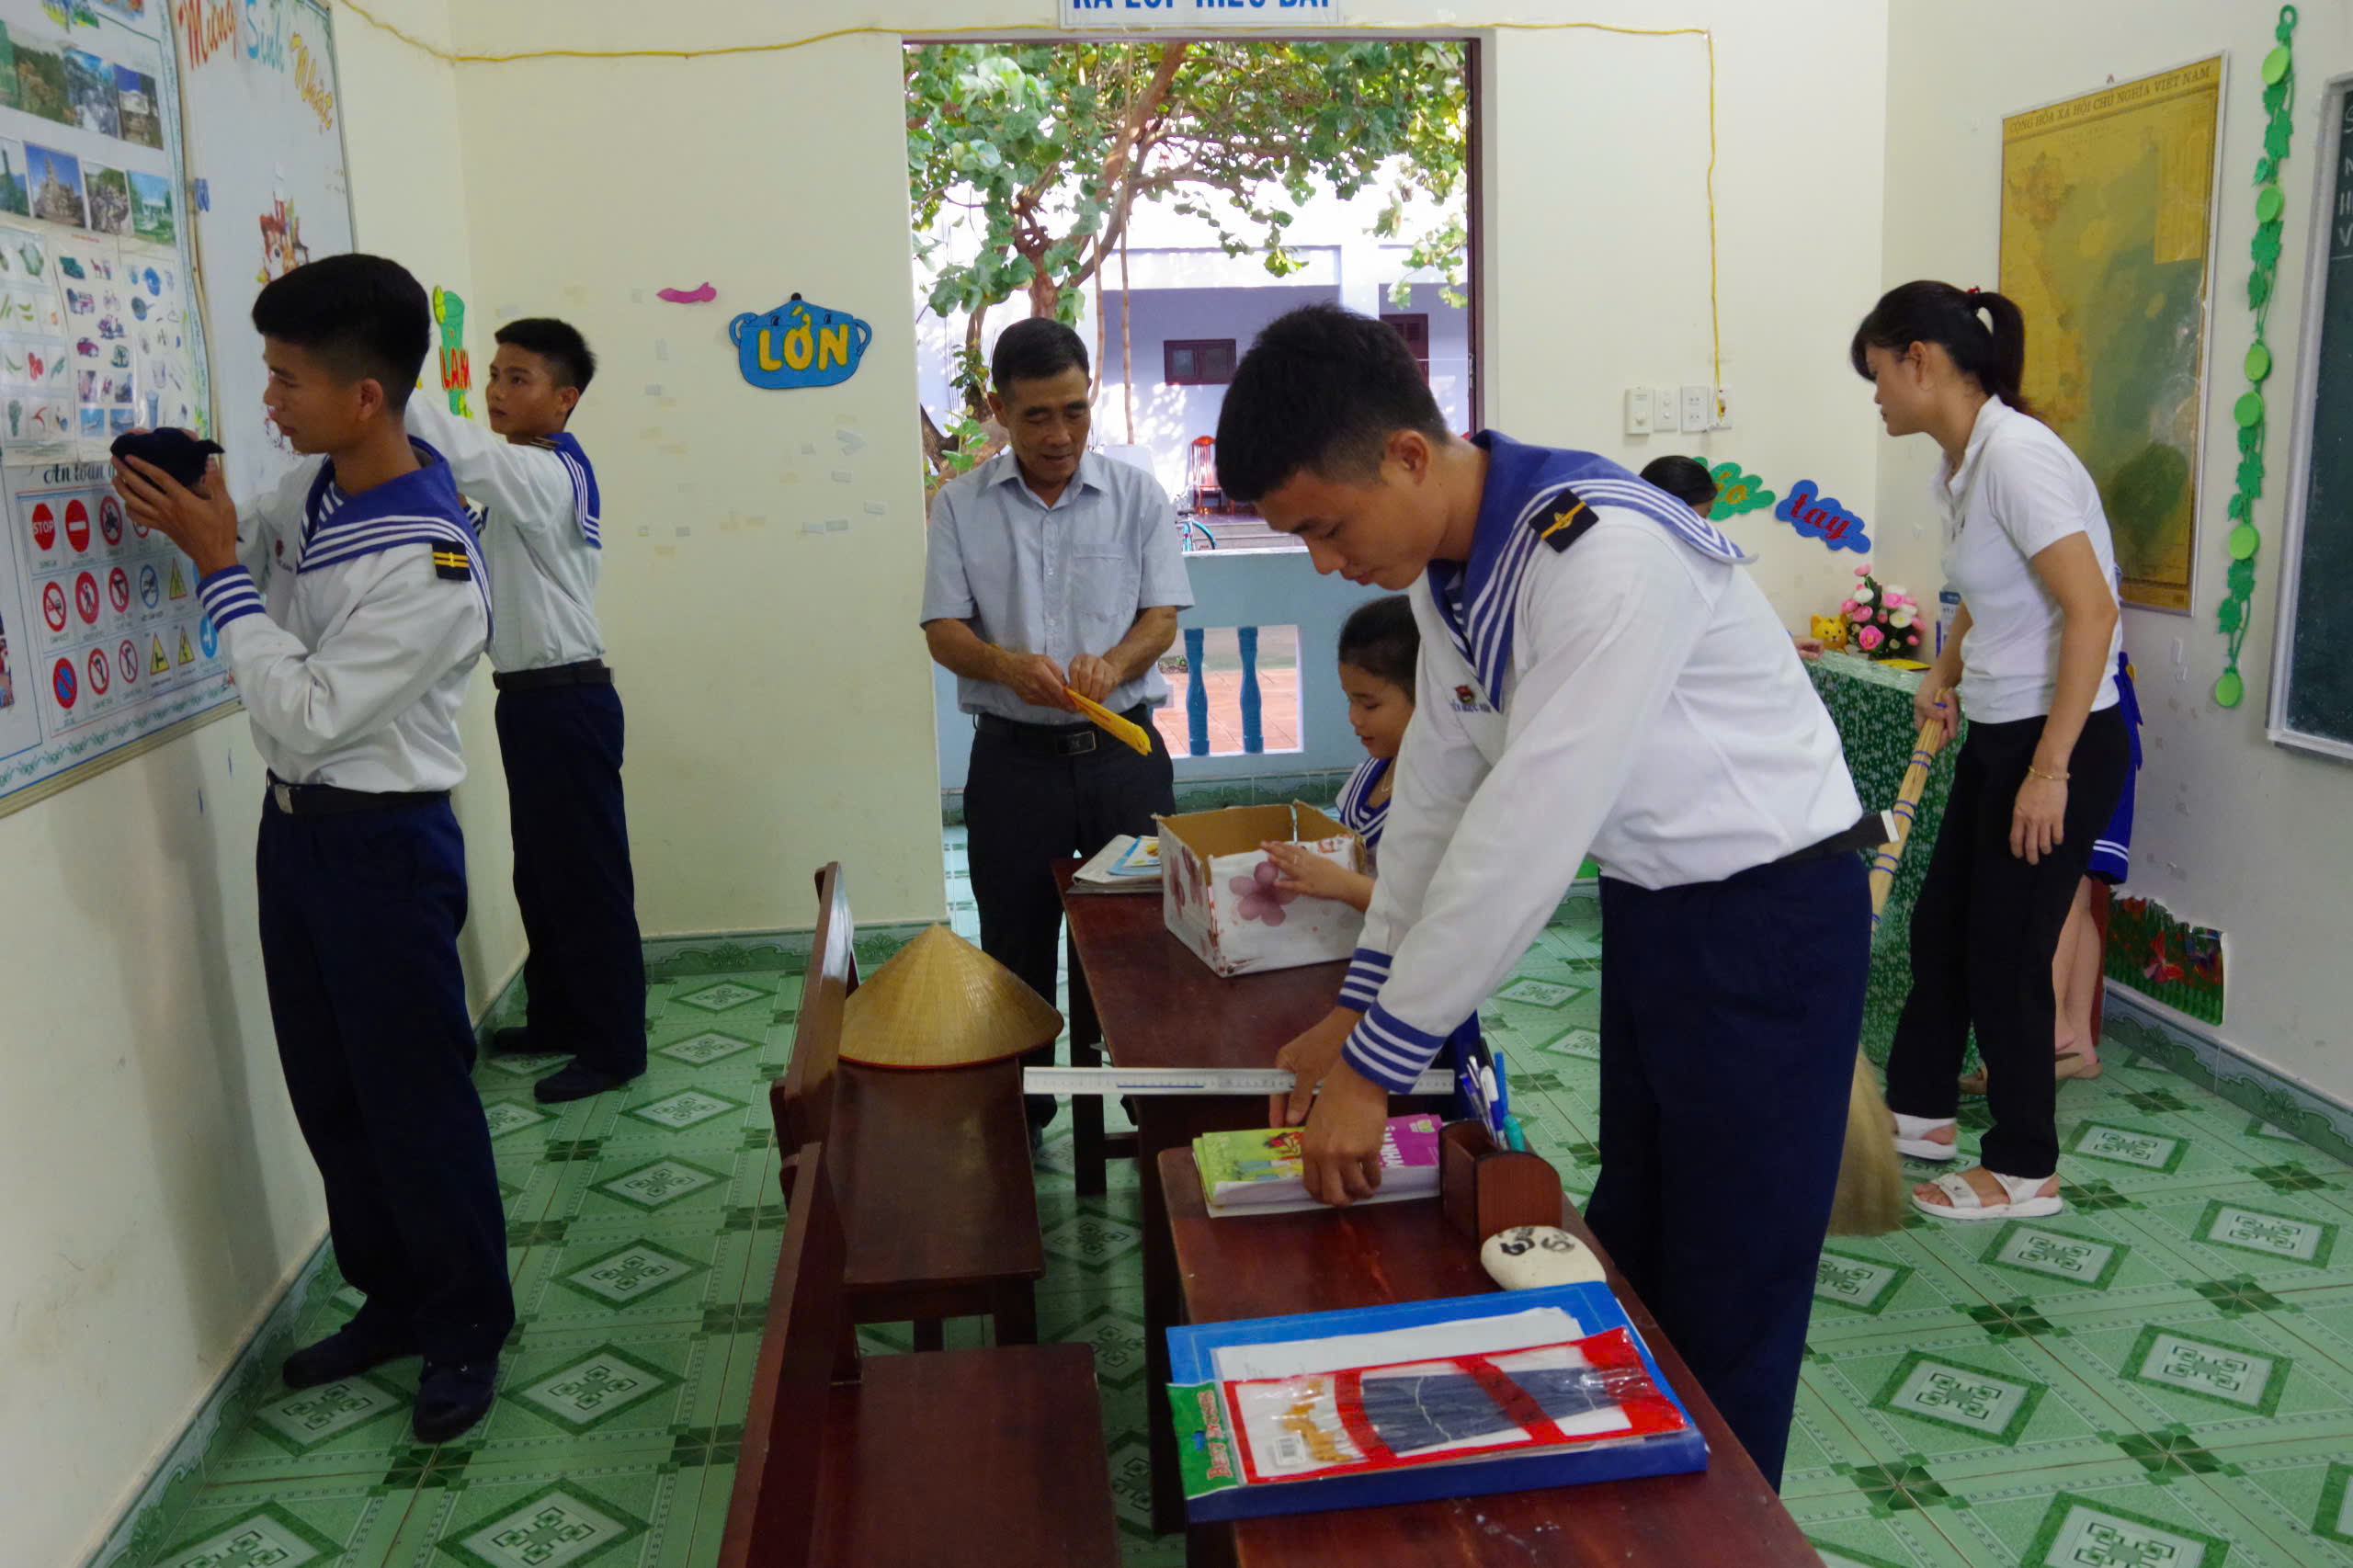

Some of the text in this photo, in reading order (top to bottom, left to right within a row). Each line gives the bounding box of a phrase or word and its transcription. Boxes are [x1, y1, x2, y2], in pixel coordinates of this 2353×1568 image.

[757, 304, 850, 372] LỚN
[32, 520, 55, 534] STOP
[1790, 493, 1851, 540] tay
